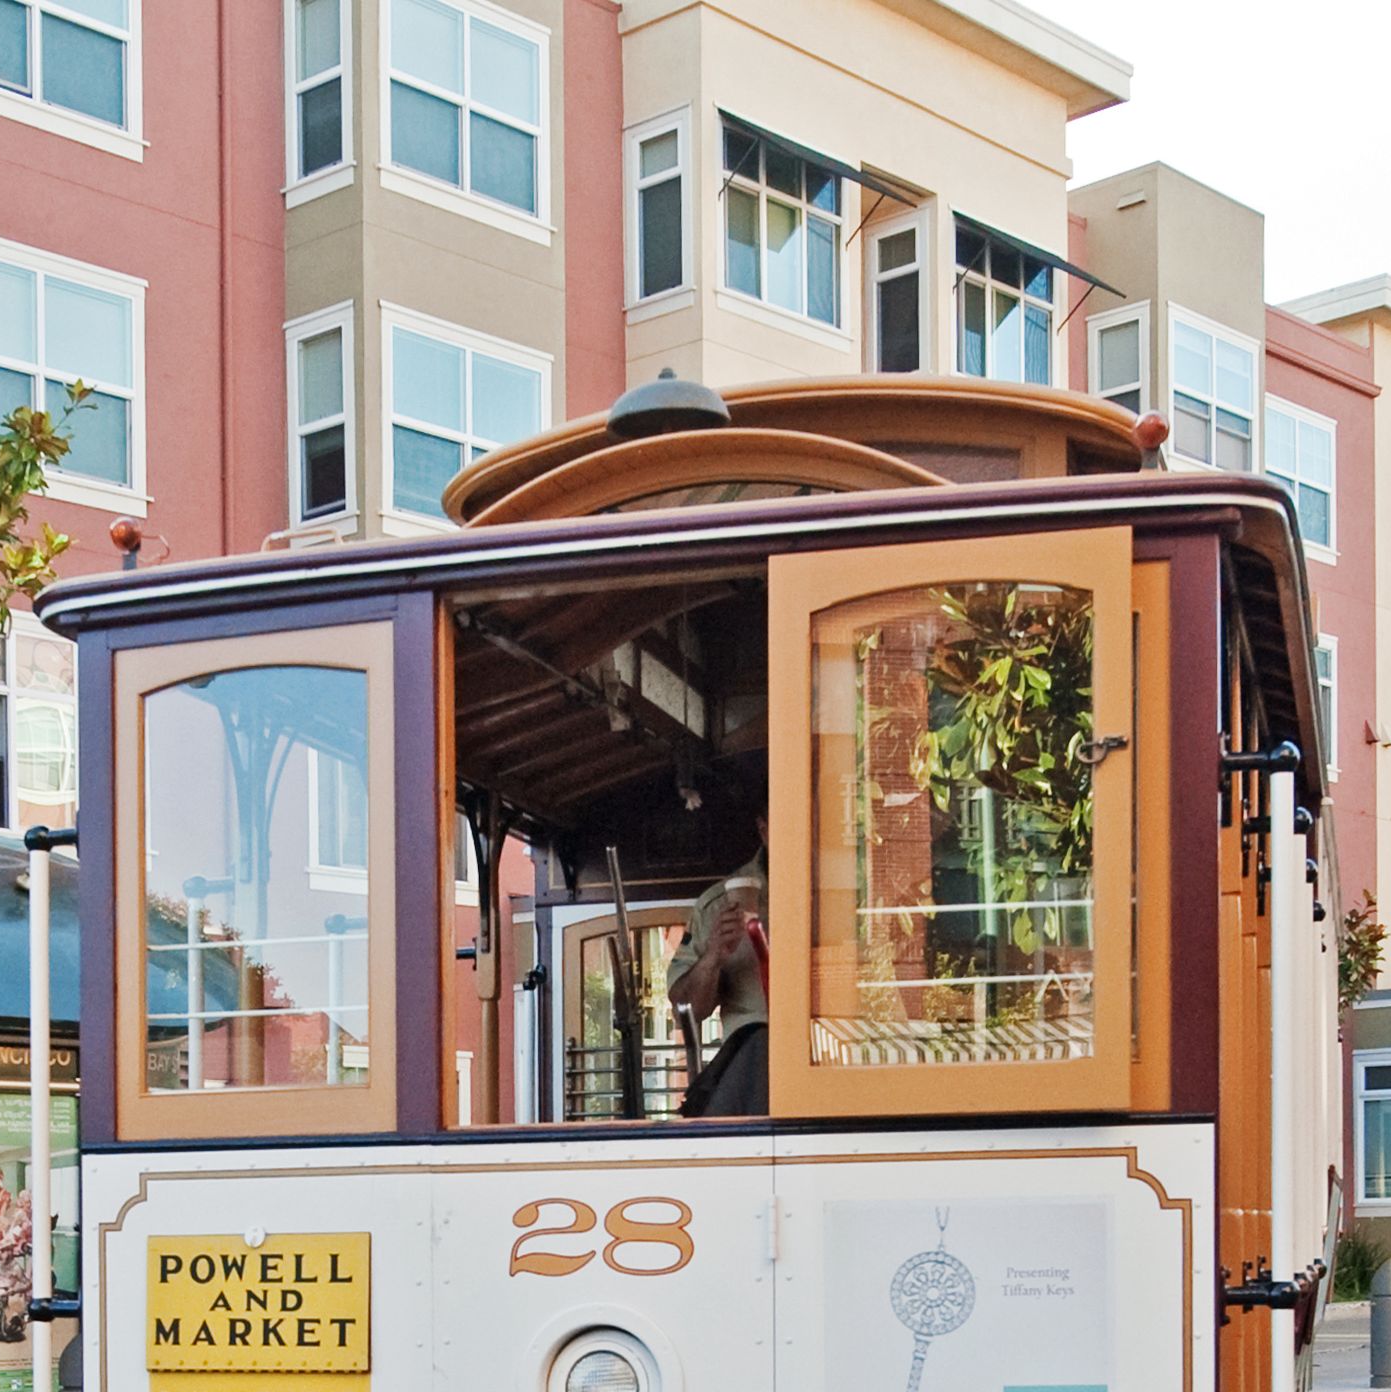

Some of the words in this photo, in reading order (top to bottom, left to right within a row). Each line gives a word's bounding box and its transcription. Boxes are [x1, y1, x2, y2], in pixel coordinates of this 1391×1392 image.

[509, 1196, 695, 1277] 28
[159, 1254, 353, 1284] POWELL
[1006, 1266, 1070, 1281] Presenting
[209, 1289, 303, 1312] AND
[1001, 1283, 1043, 1300] Tiffany
[1046, 1283, 1075, 1300] Keys
[154, 1318, 356, 1347] MARKET
